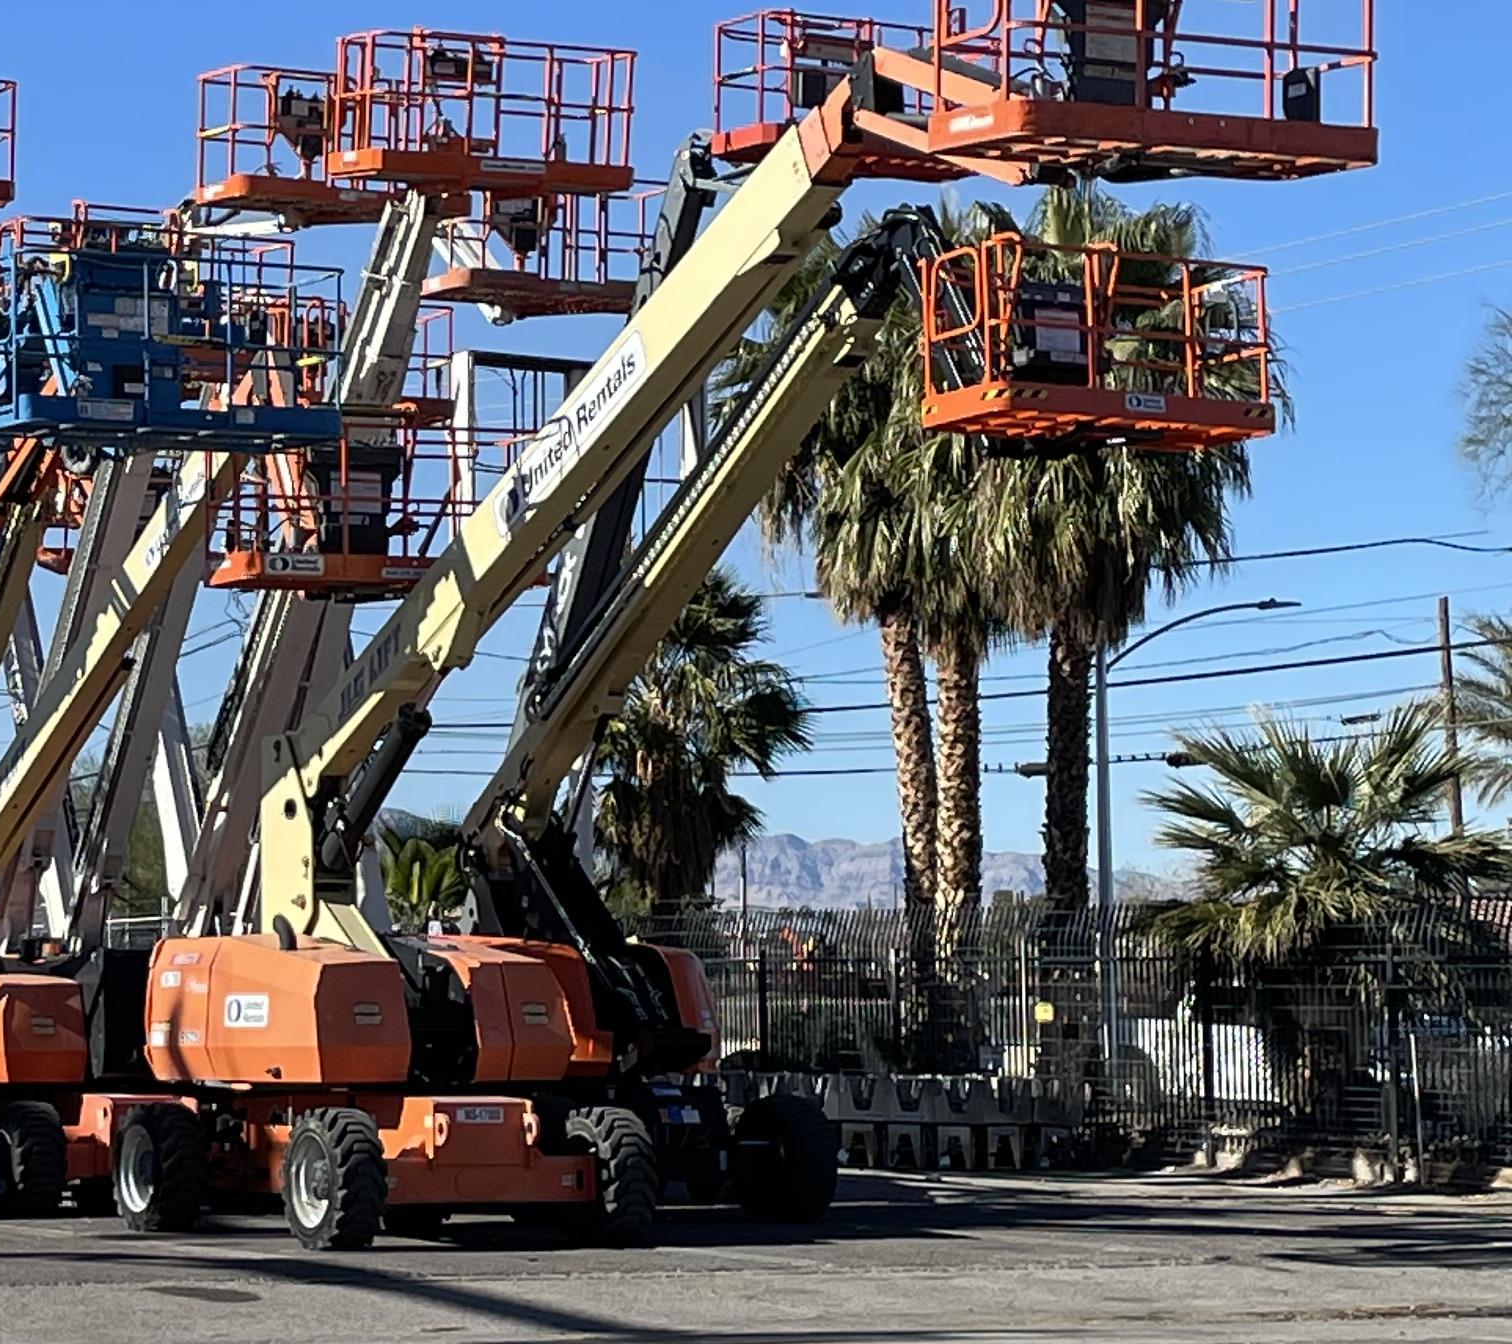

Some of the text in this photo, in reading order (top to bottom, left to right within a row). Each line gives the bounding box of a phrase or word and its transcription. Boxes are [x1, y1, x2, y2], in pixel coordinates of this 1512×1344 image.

[521, 352, 637, 494] United Rentals
[338, 622, 401, 724] JLG LIFT
